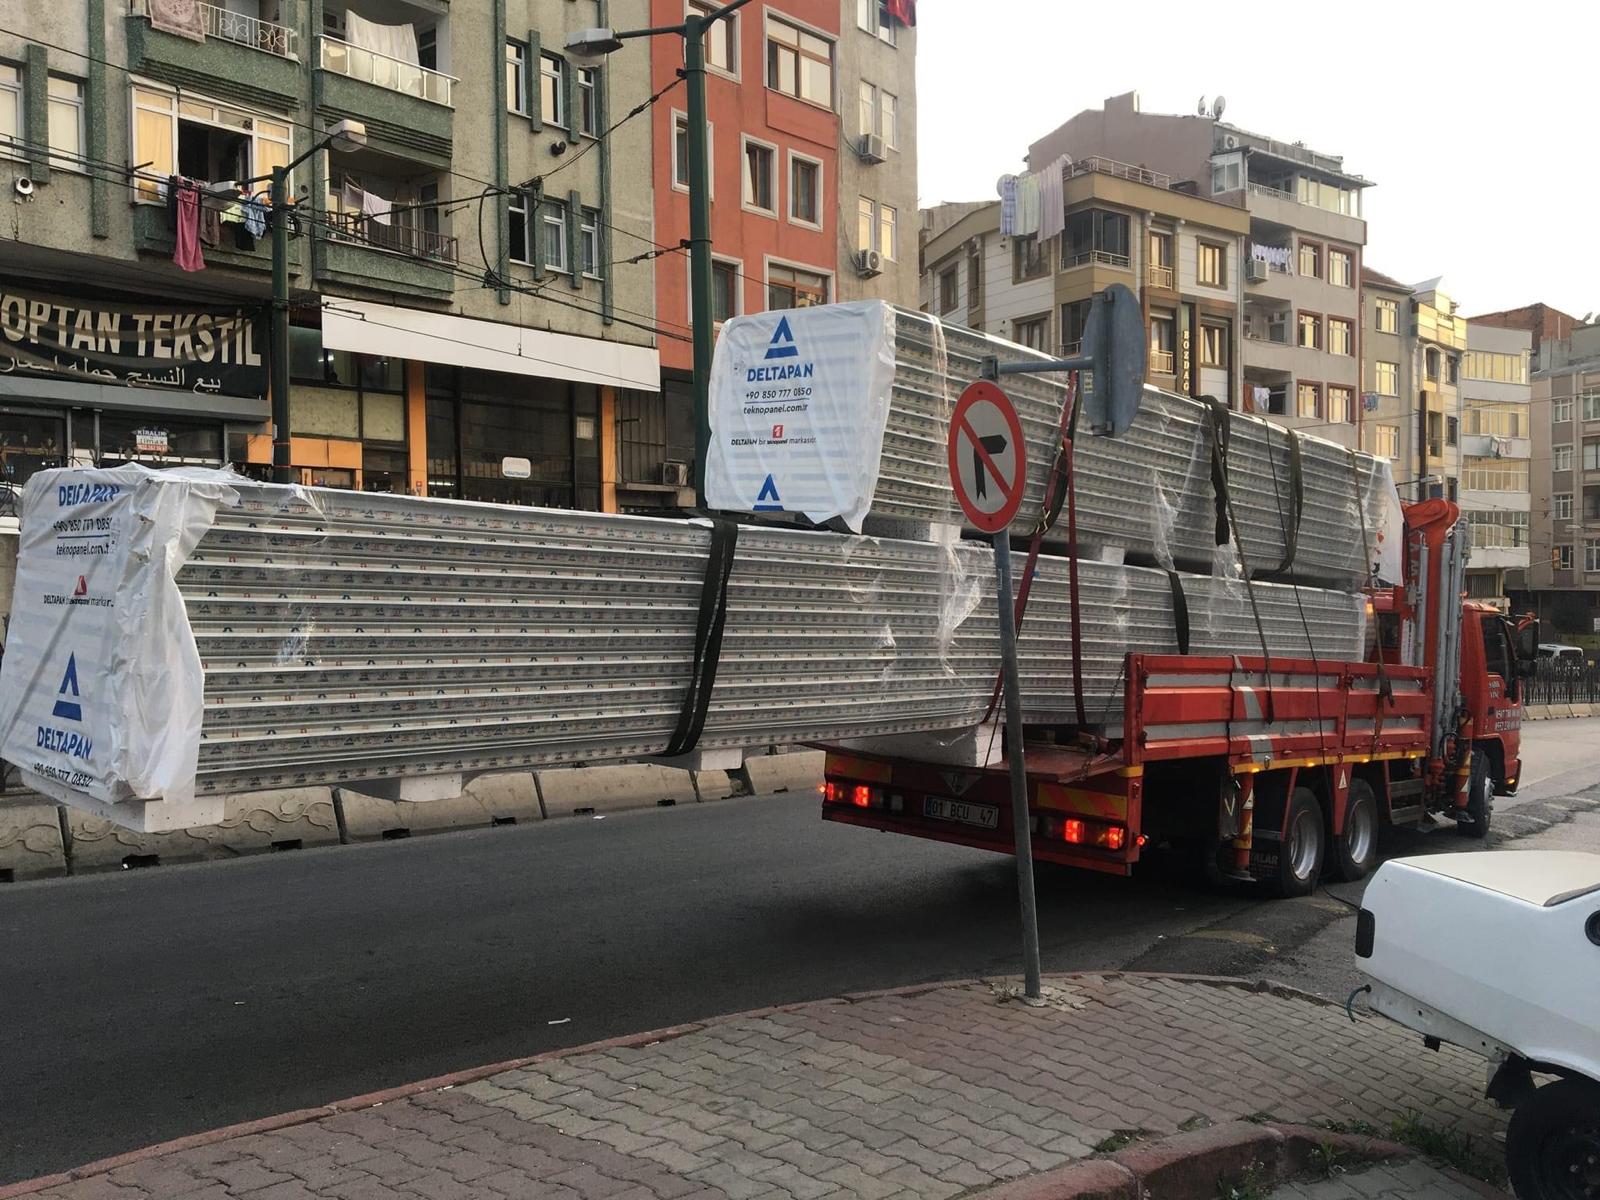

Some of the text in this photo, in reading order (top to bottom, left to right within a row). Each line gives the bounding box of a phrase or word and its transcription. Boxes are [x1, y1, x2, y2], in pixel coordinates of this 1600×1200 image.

[0, 293, 262, 366] OPTAN TEKSTİL
[747, 363, 813, 382] DELTAPAN
[746, 391, 760, 400] +90
[762, 390, 777, 399] 850
[778, 389, 792, 398] 777
[37, 726, 93, 760] DELTAPAN
[71, 772, 94, 788] 0850
[979, 808, 994, 826] 47
